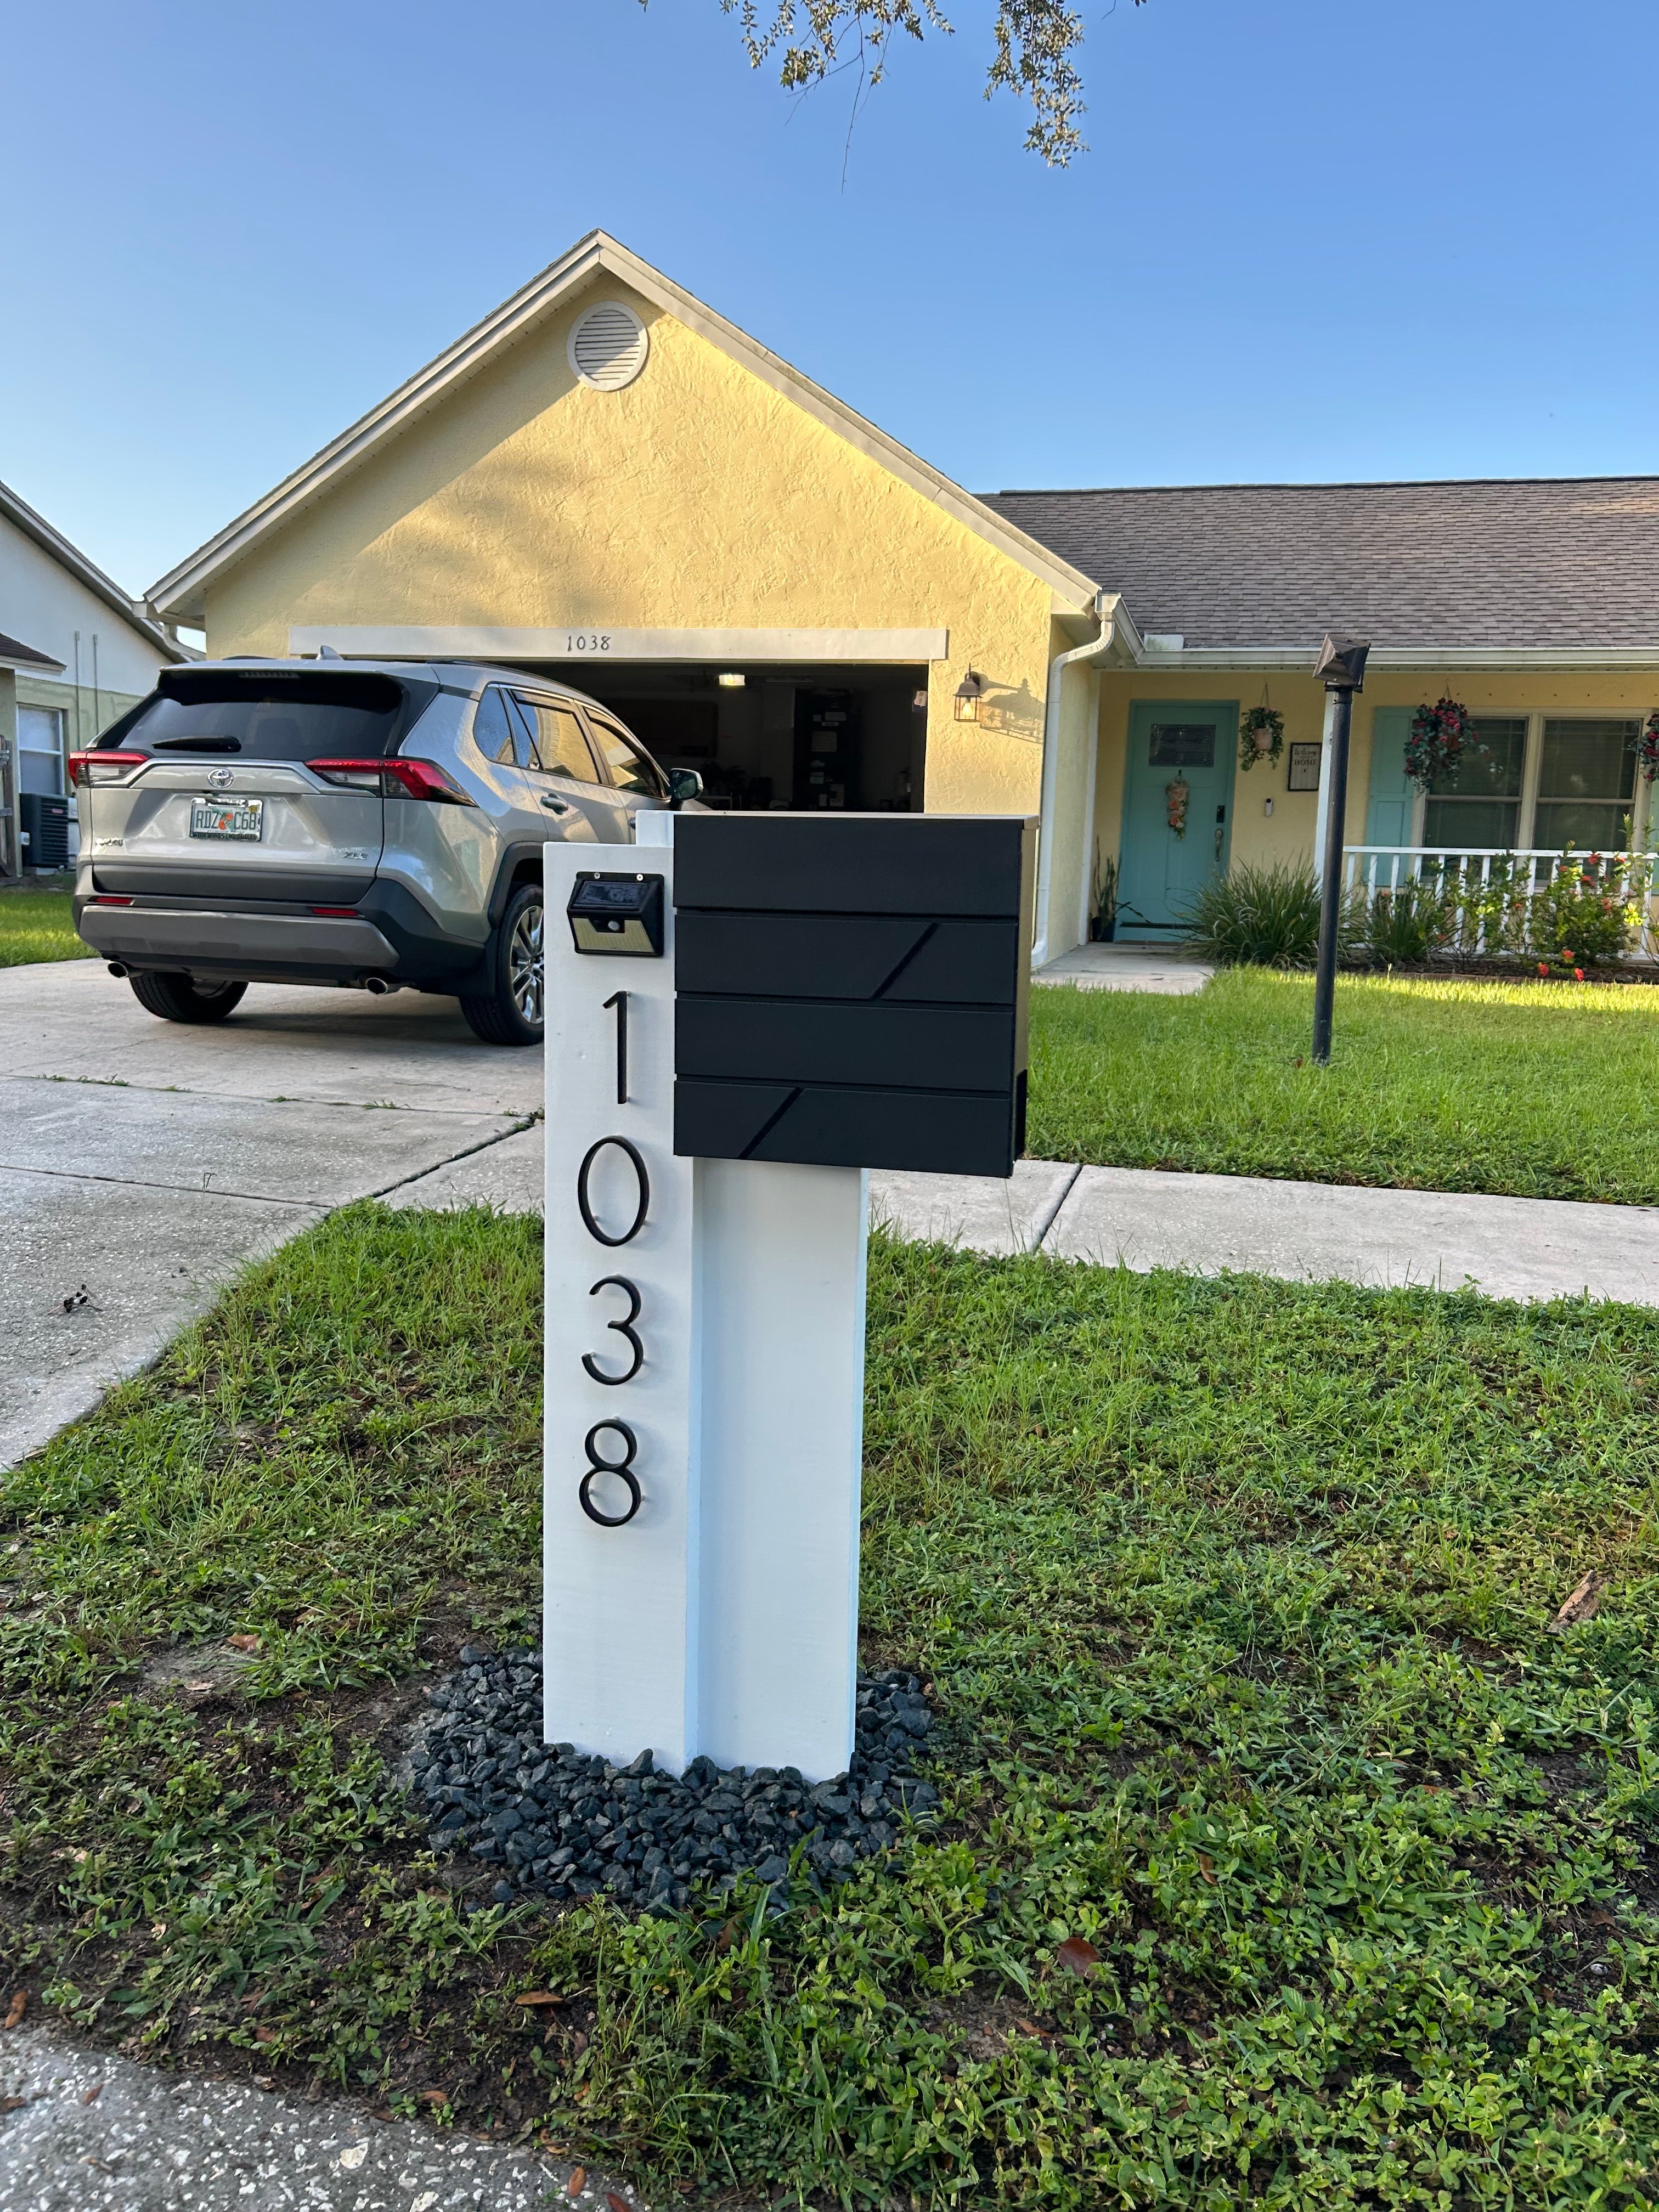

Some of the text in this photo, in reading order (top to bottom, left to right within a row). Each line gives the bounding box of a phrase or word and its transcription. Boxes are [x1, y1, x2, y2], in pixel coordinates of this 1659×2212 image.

[567, 635, 612, 652] 1038
[196, 810, 257, 830] RDZ C68
[577, 990, 650, 1527] 1038
